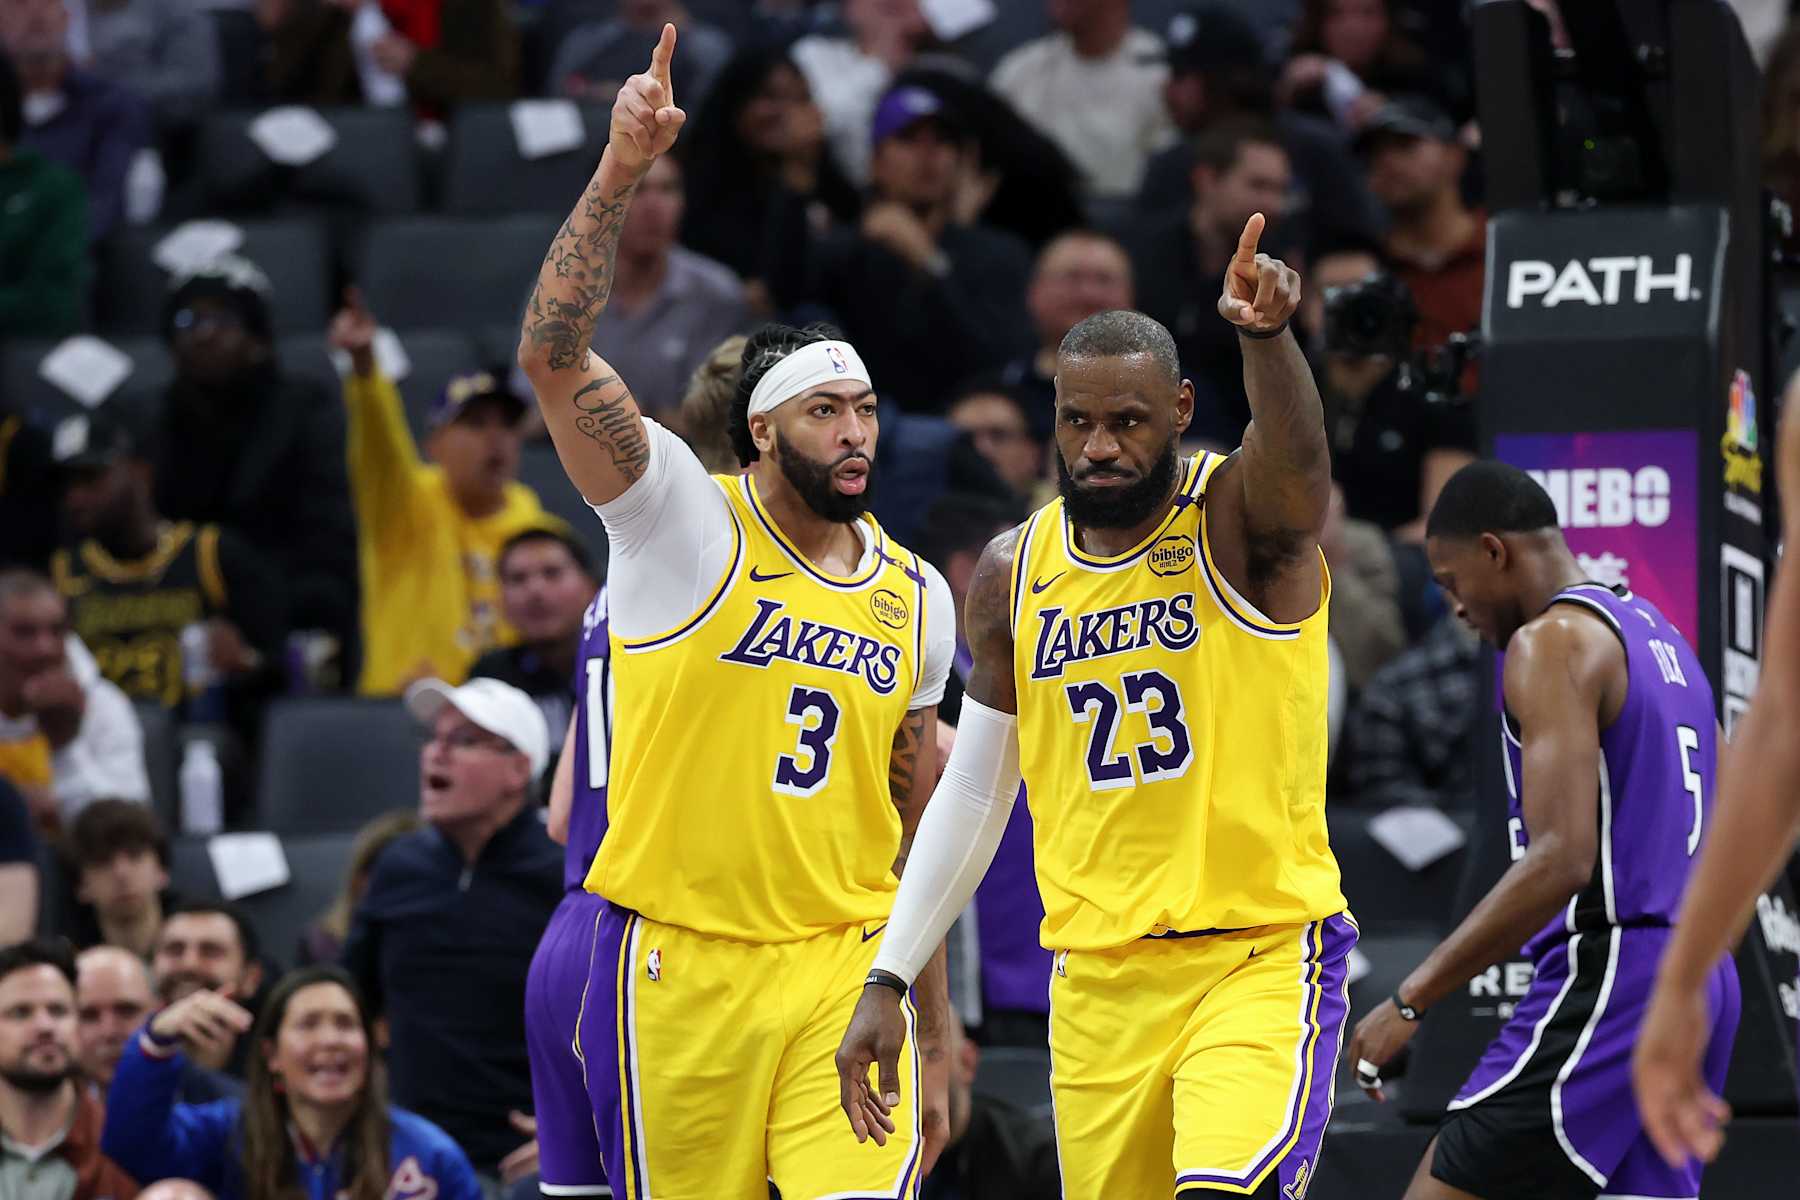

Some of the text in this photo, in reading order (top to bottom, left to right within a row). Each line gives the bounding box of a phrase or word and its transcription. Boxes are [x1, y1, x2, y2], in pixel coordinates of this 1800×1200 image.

[1151, 546, 1193, 562] bibigo
[718, 597, 901, 697] LAKERS
[873, 596, 906, 620] bibigo
[1030, 592, 1200, 681] LAKERS
[586, 657, 615, 789] 1
[771, 683, 842, 798] 3
[1064, 668, 1195, 792] 23
[1676, 725, 1703, 858] 5
